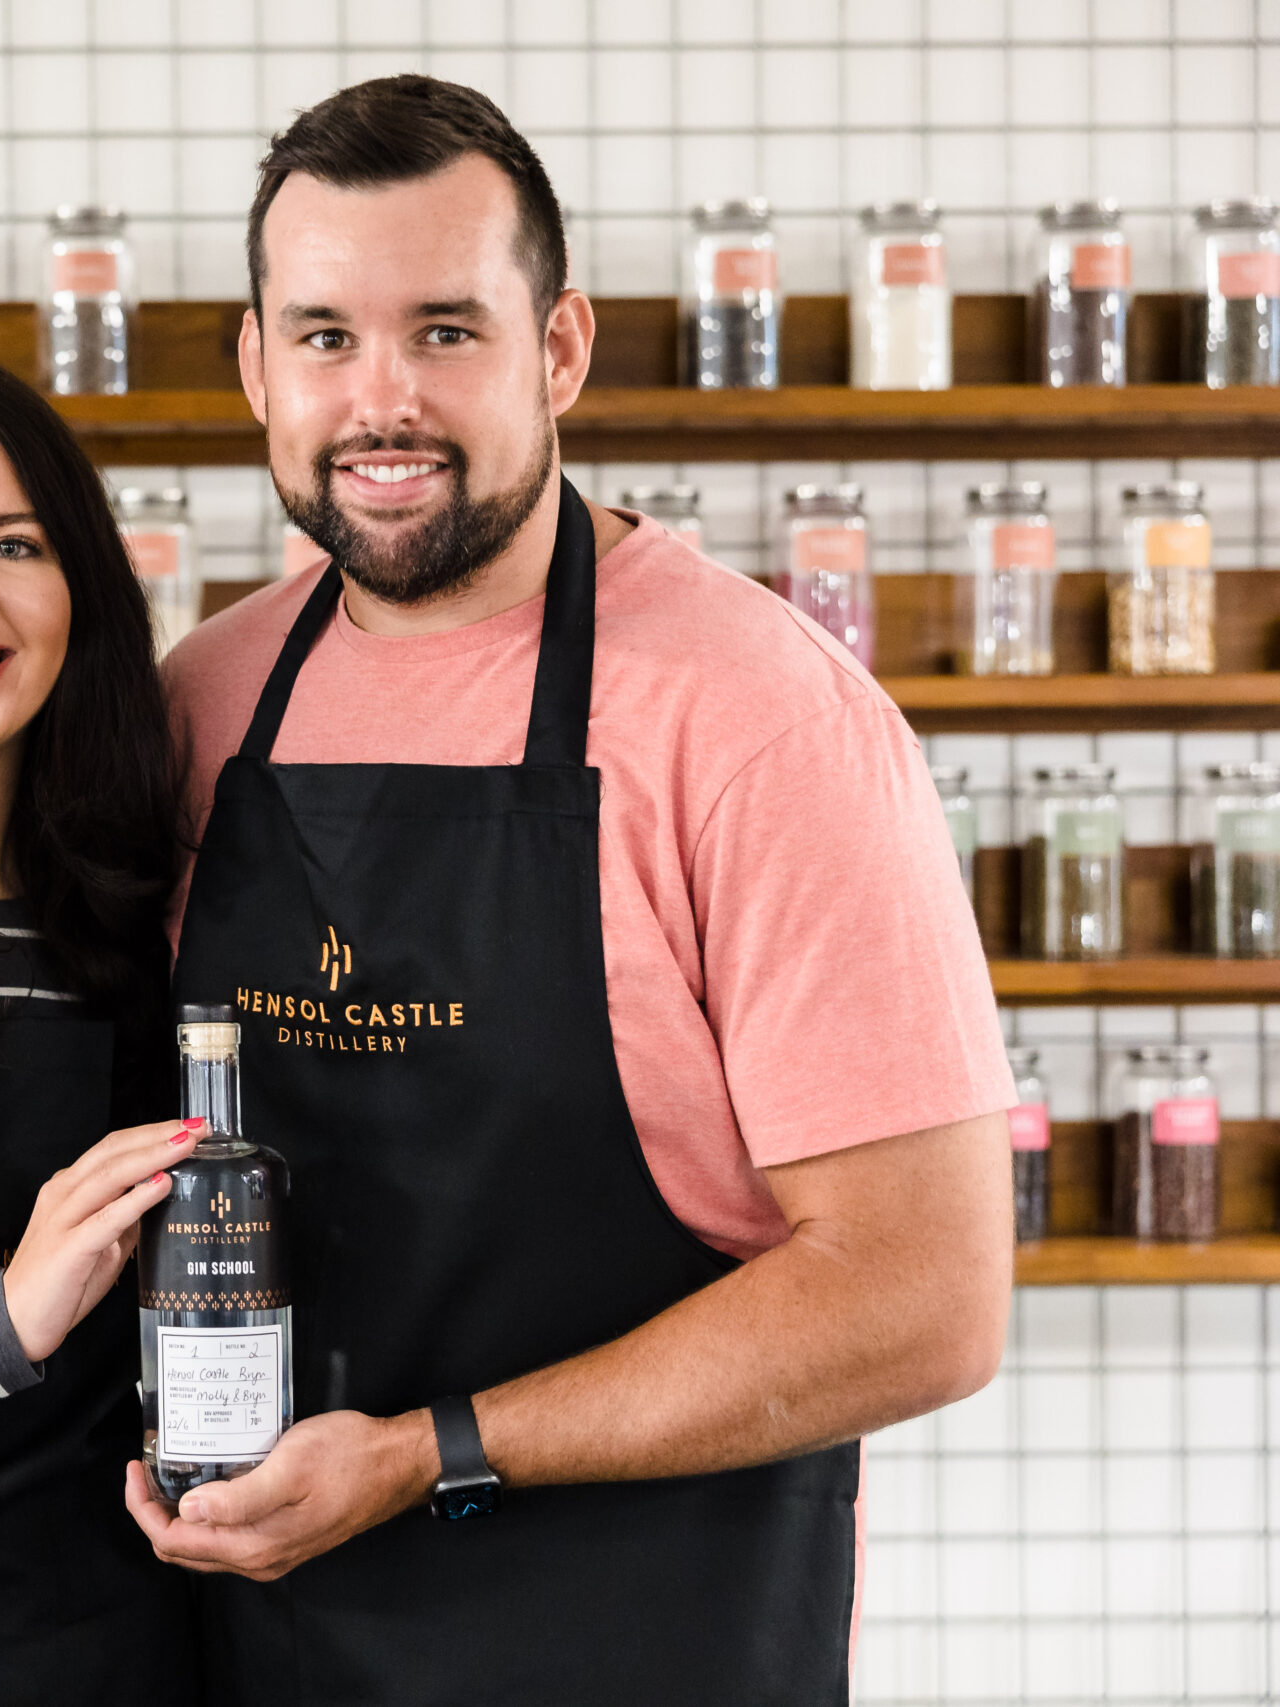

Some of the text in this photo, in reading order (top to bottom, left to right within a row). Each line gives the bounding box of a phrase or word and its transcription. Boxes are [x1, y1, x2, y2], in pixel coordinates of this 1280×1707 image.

[237, 986, 464, 1027] HENSOL CASTLE
[278, 1026, 406, 1053] DISTILLERY
[167, 1221, 272, 1234] HENSOL CASTLE
[190, 1235, 251, 1245] DISTILLERY
[187, 1260, 256, 1275] GIN SCHOOL
[191, 1345, 199, 1358] 1
[248, 1342, 259, 1359] 2
[199, 1367, 230, 1381] Castle
[196, 1388, 229, 1407] Molly
